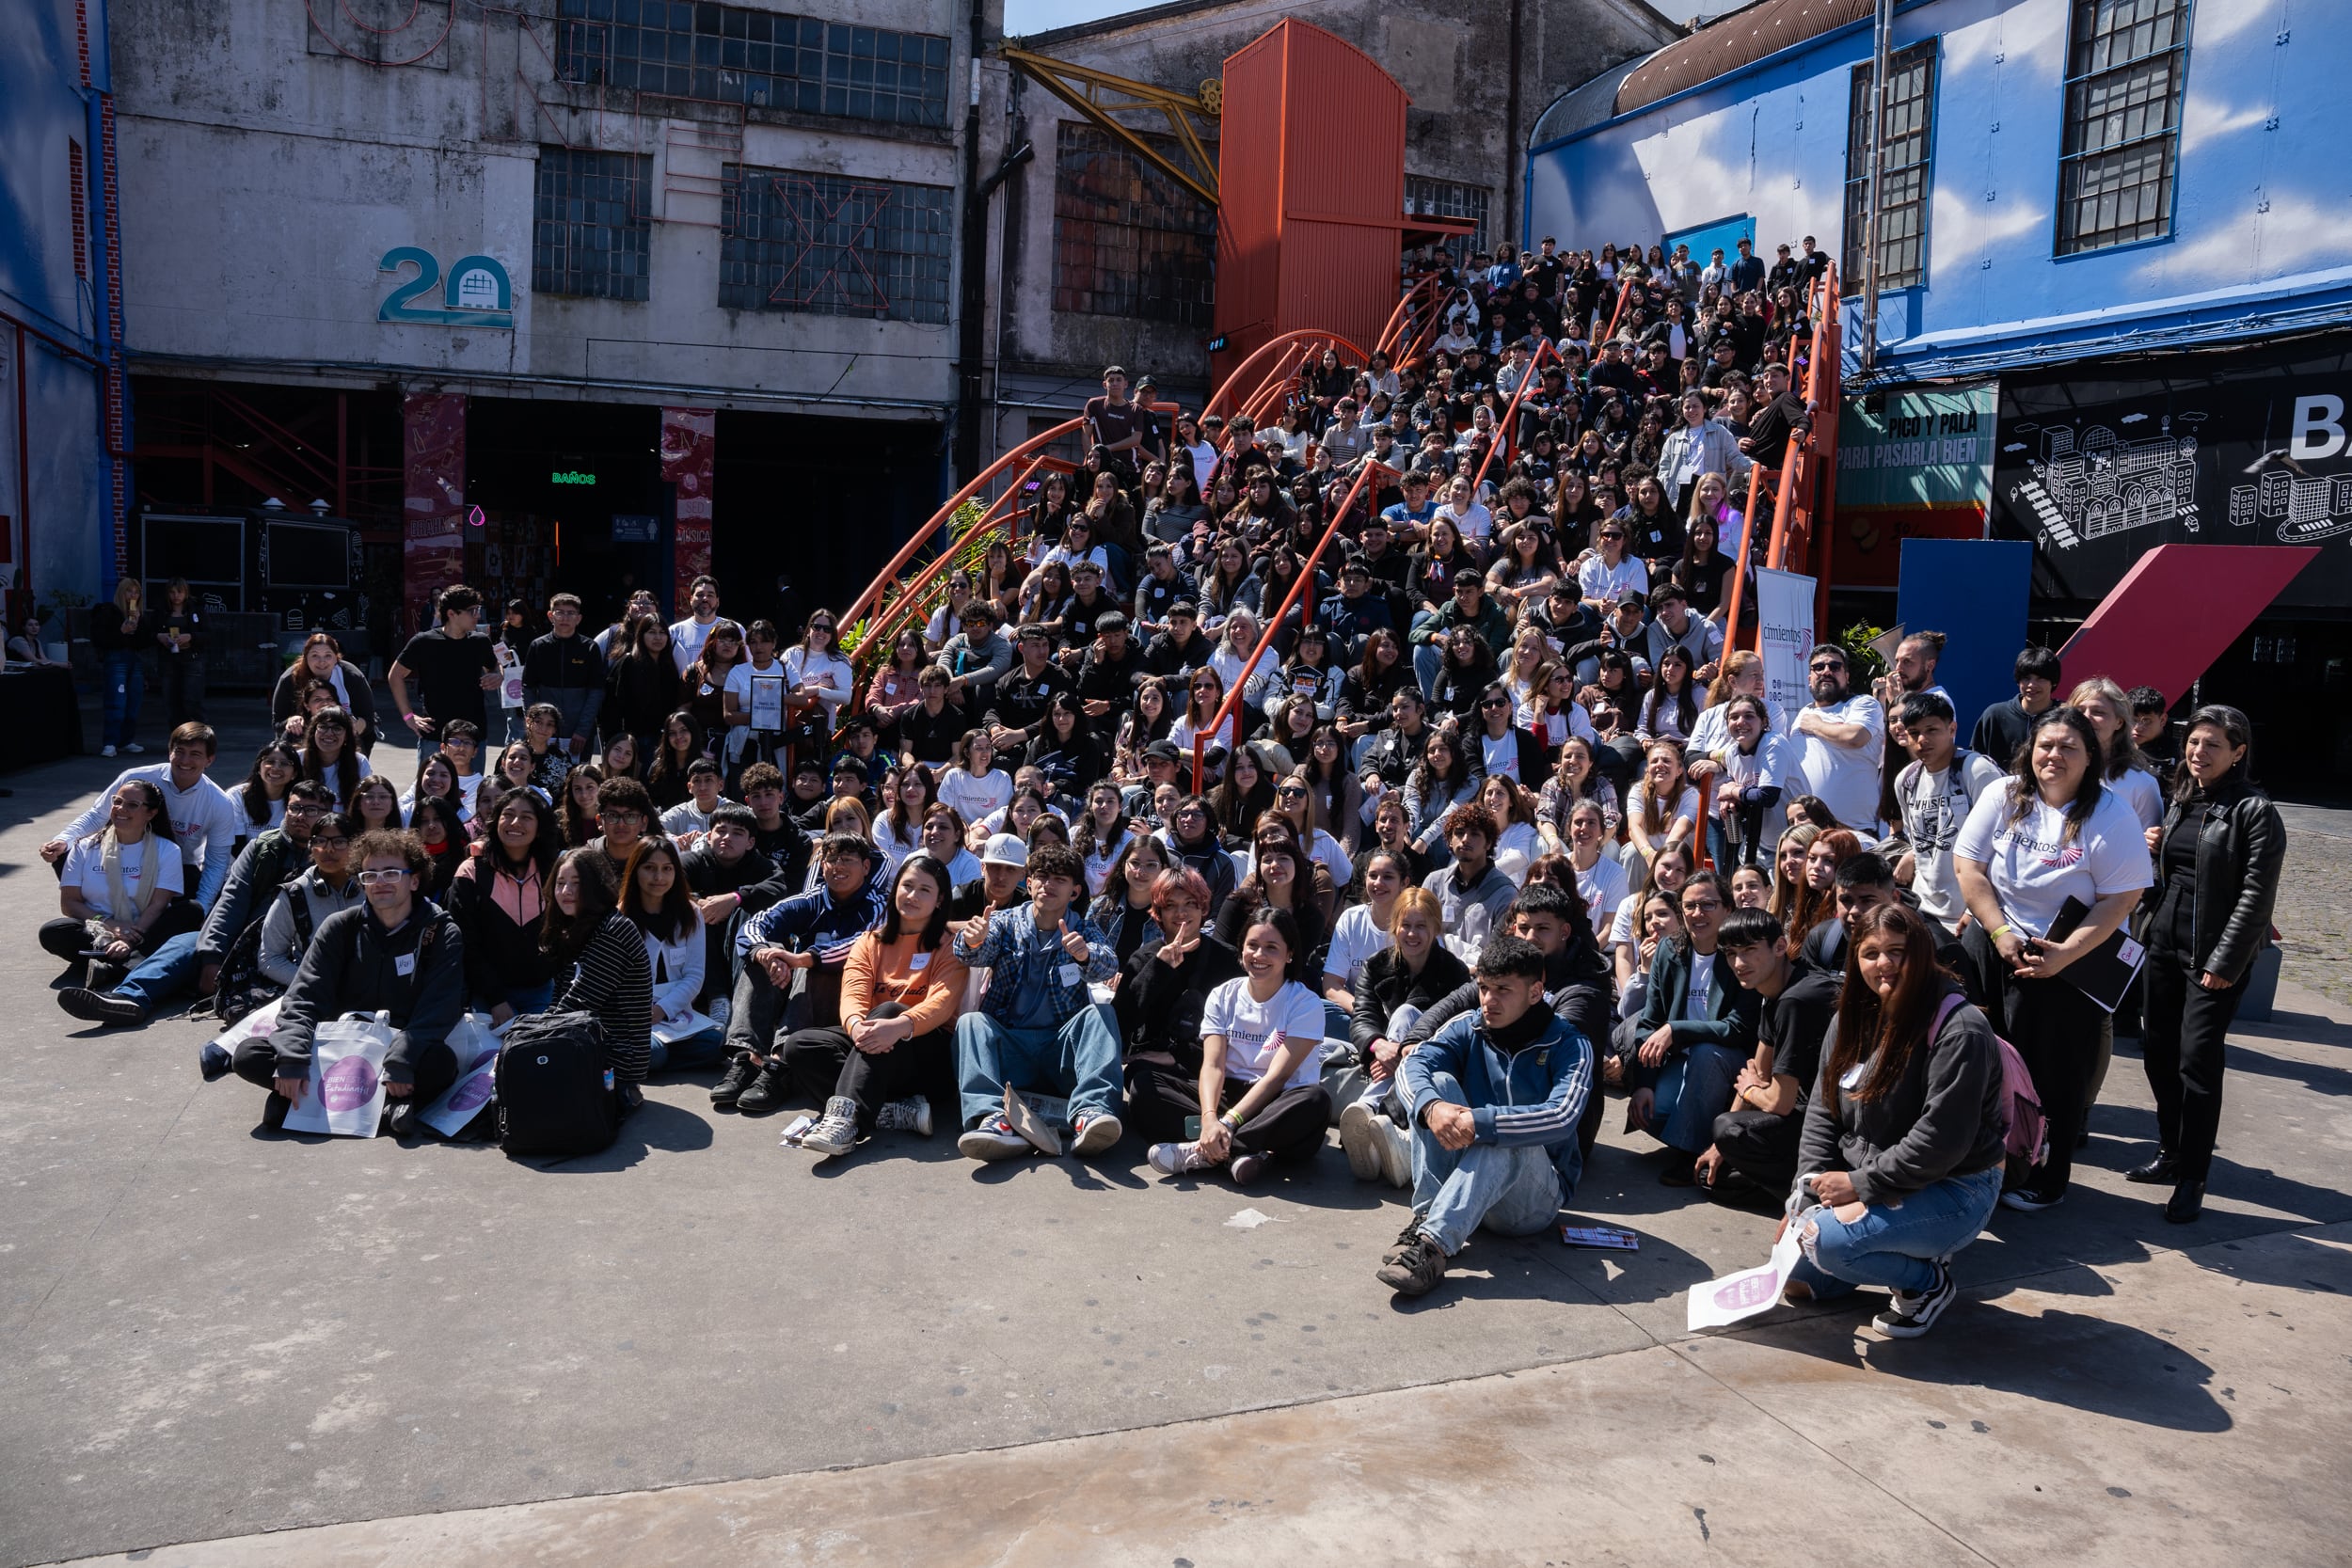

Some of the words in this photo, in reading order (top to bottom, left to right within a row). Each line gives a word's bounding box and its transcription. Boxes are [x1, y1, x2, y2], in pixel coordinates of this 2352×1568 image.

[1888, 417, 1921, 438] PICO
[1925, 415, 1935, 436] Y
[1940, 411, 1978, 435] PALA
[2290, 393, 2352, 460] B
[1836, 445, 1869, 469] PARA
[1874, 440, 1938, 467] PASARLA
[1942, 437, 1978, 464] BIEN
[2086, 451, 2112, 468] KONEX
[552, 471, 596, 485] BAÑOS
[686, 500, 704, 514] SED
[677, 528, 711, 544] MÚSICA
[1763, 622, 1802, 643] cimientos
[1993, 829, 2058, 854] cimientos
[1226, 1029, 1271, 1042] cmientos
